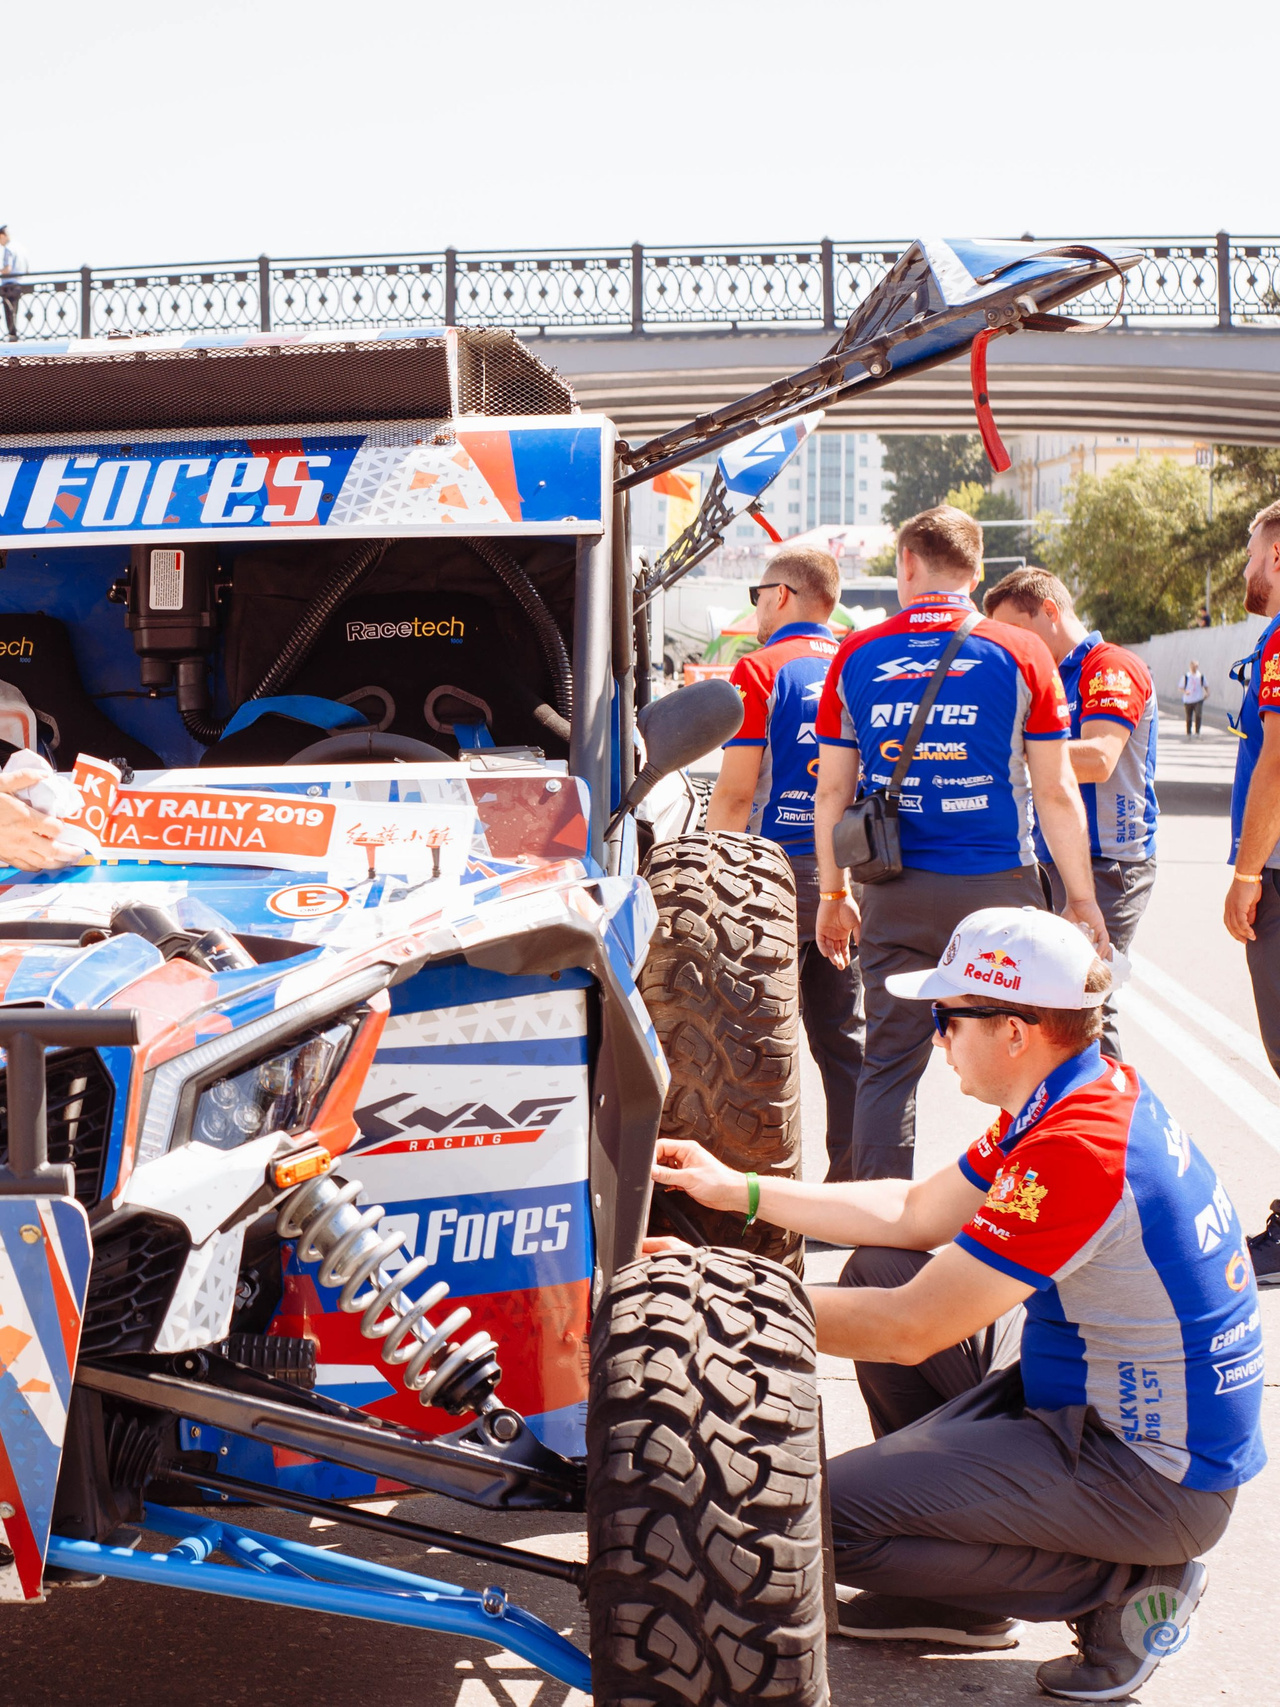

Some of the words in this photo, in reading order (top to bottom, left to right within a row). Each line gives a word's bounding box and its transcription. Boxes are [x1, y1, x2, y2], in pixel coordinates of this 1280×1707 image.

[22, 454, 331, 529] Fores
[346, 616, 465, 641] Racetech
[909, 612, 953, 623] RUSSIA
[158, 799, 255, 821] RALLY
[256, 803, 325, 827] 2019
[964, 963, 994, 983] Red
[993, 971, 1021, 991] Bull
[409, 1133, 502, 1152] RACING
[424, 1203, 572, 1267] Fores
[1225, 1355, 1264, 1383] RAVENO
[1145, 1412, 1161, 1439] 018
